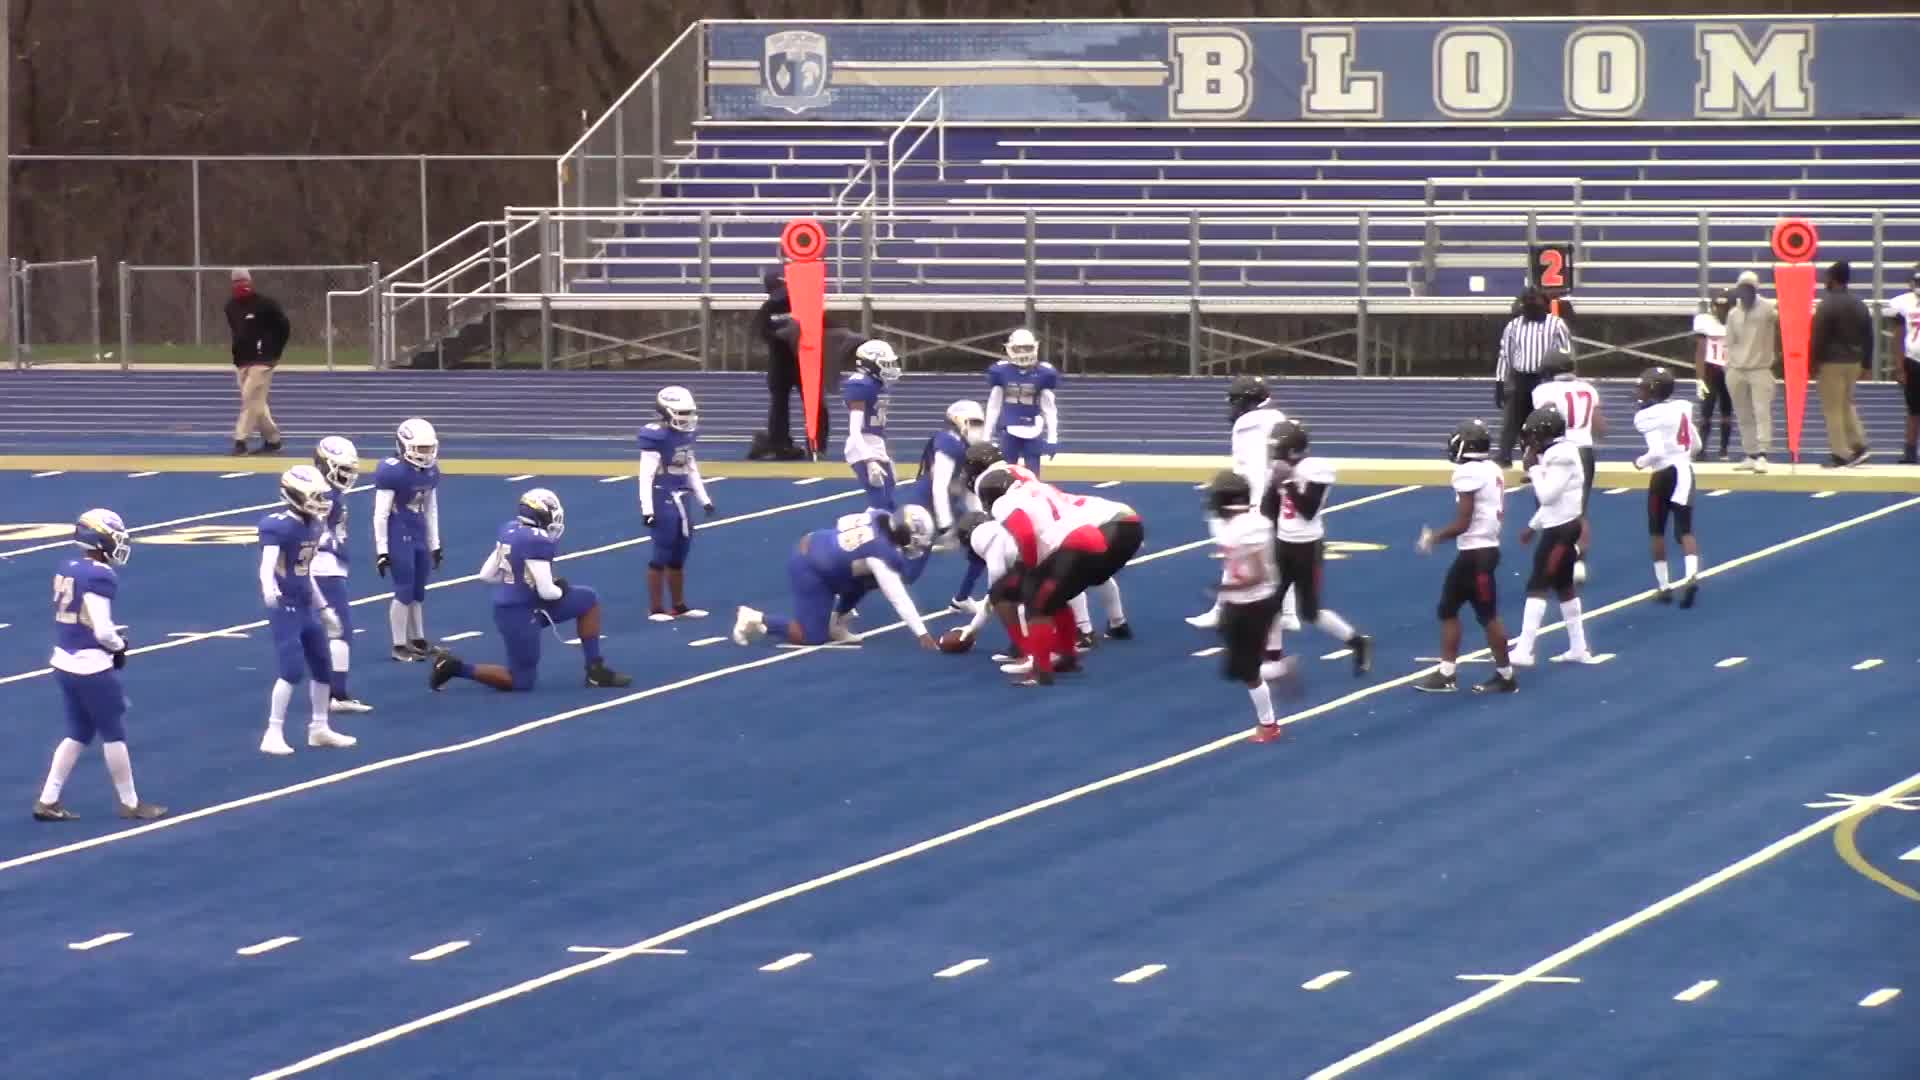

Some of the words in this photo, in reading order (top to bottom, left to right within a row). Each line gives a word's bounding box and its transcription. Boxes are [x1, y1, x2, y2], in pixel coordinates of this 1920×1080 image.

[1168, 23, 1816, 119] BLOOM
[1539, 248, 1564, 287] 2
[1565, 391, 1593, 429] 17
[1676, 411, 1692, 452] 4
